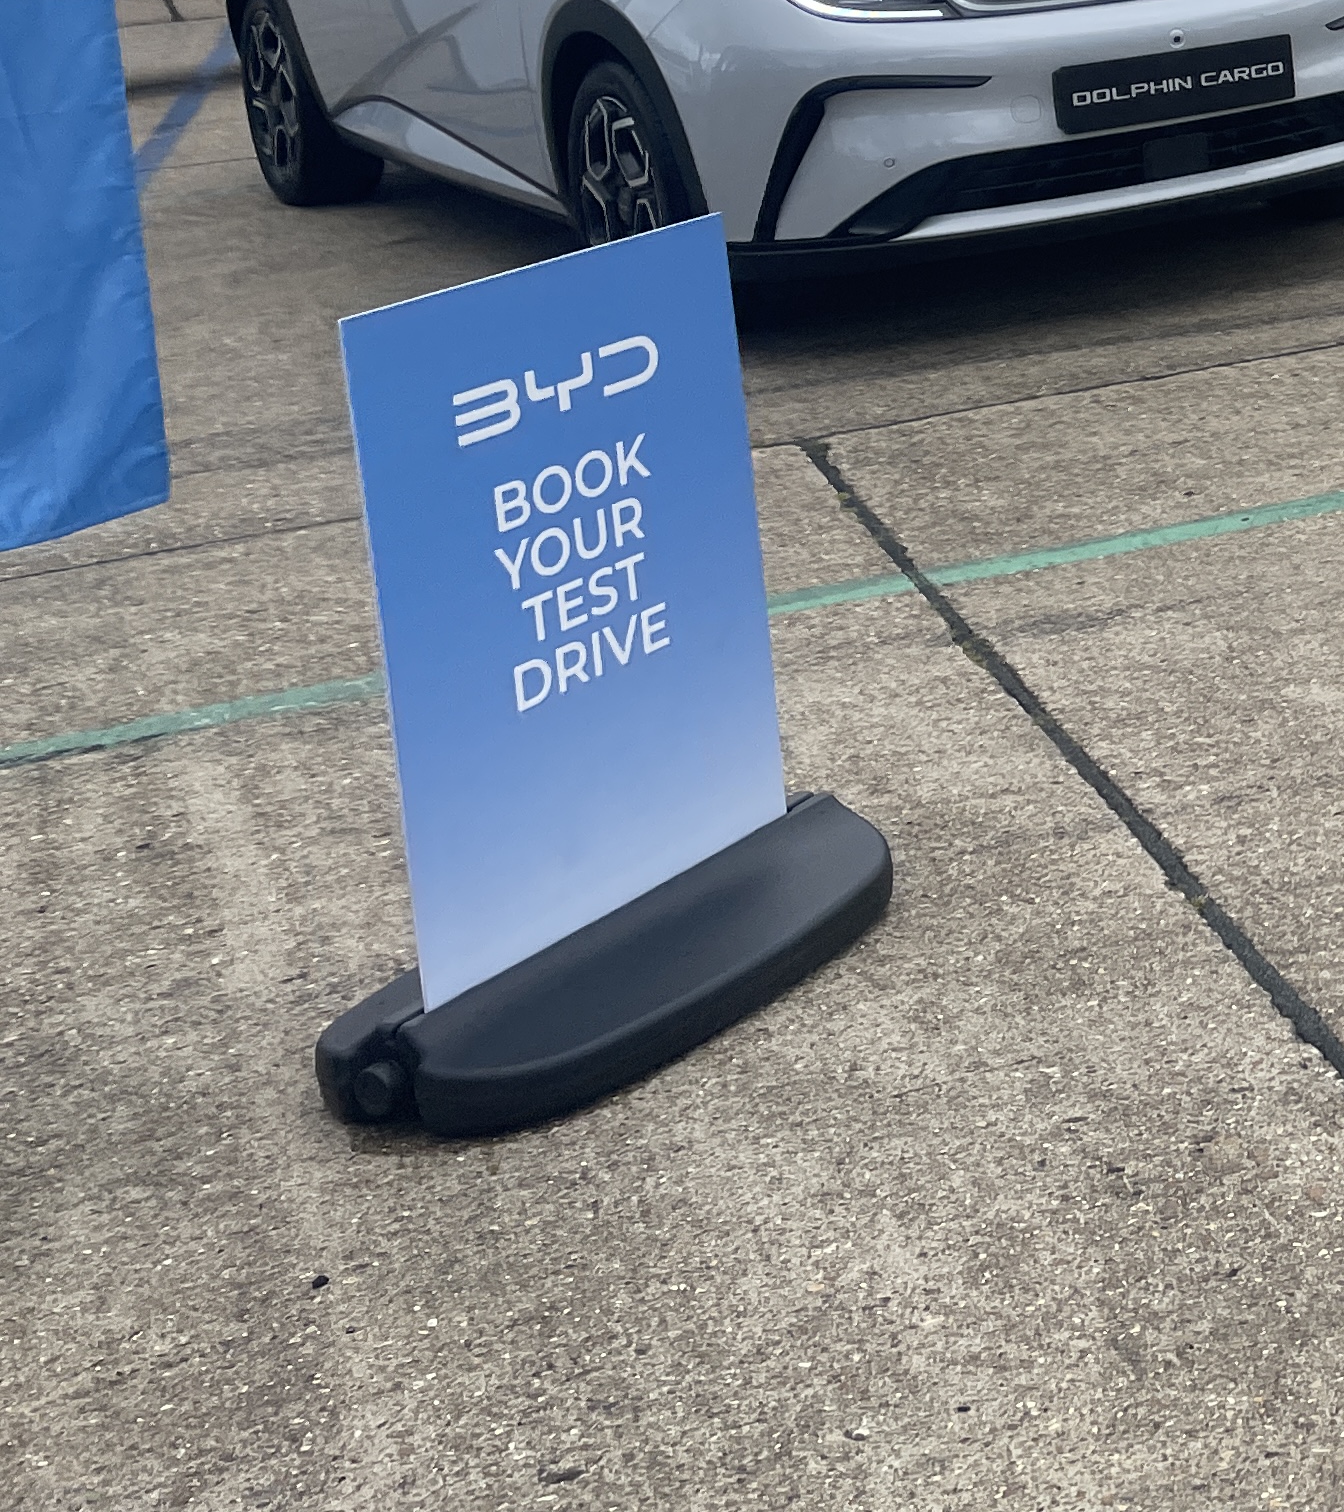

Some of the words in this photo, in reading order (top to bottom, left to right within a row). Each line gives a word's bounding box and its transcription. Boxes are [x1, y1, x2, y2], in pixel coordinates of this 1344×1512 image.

[1071, 75, 1193, 107] DOLPHIN
[1200, 61, 1285, 87] CARGO
[452, 334, 660, 447] BYD
[494, 433, 652, 533] BOOK
[494, 497, 645, 590] YOUR
[522, 552, 645, 641] TEST
[513, 601, 671, 713] DRIVE
